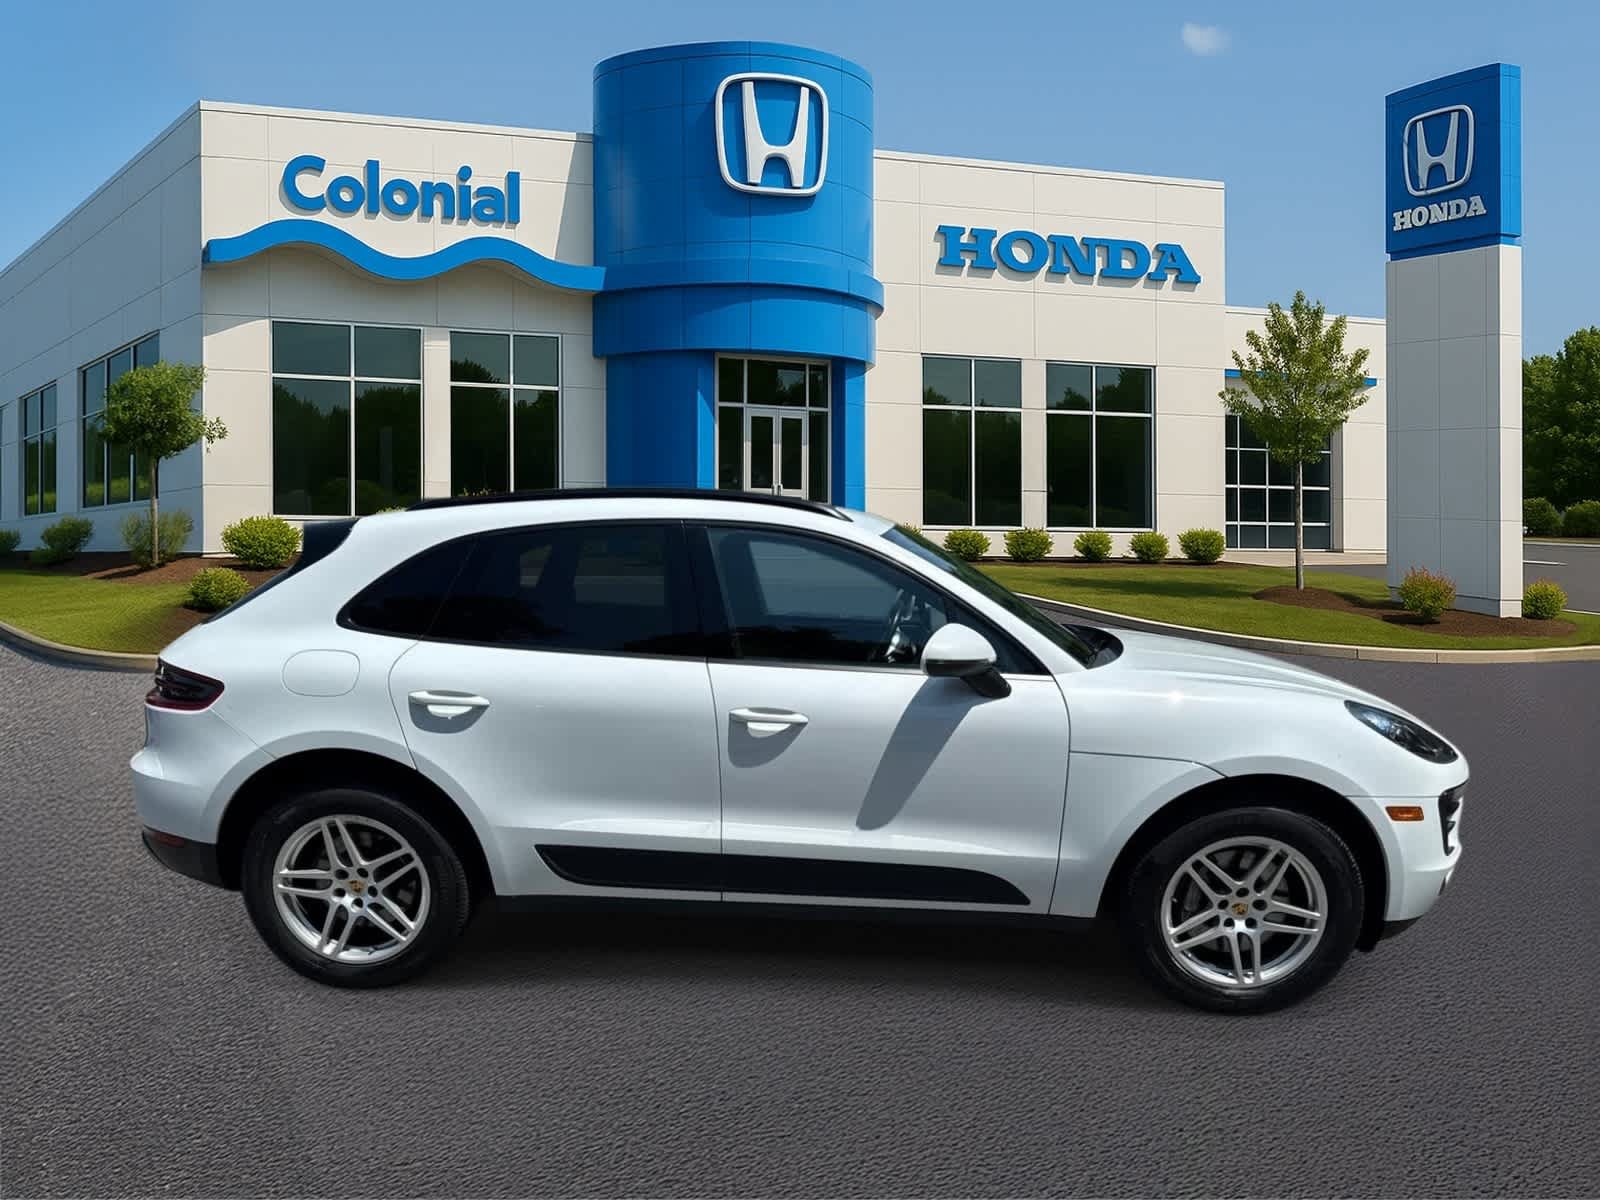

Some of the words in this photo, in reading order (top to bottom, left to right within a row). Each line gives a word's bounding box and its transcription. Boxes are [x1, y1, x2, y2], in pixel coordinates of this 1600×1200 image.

[281, 154, 520, 225] Colonial
[1393, 195, 1487, 232] HONDA
[937, 224, 1202, 284] HONDA
